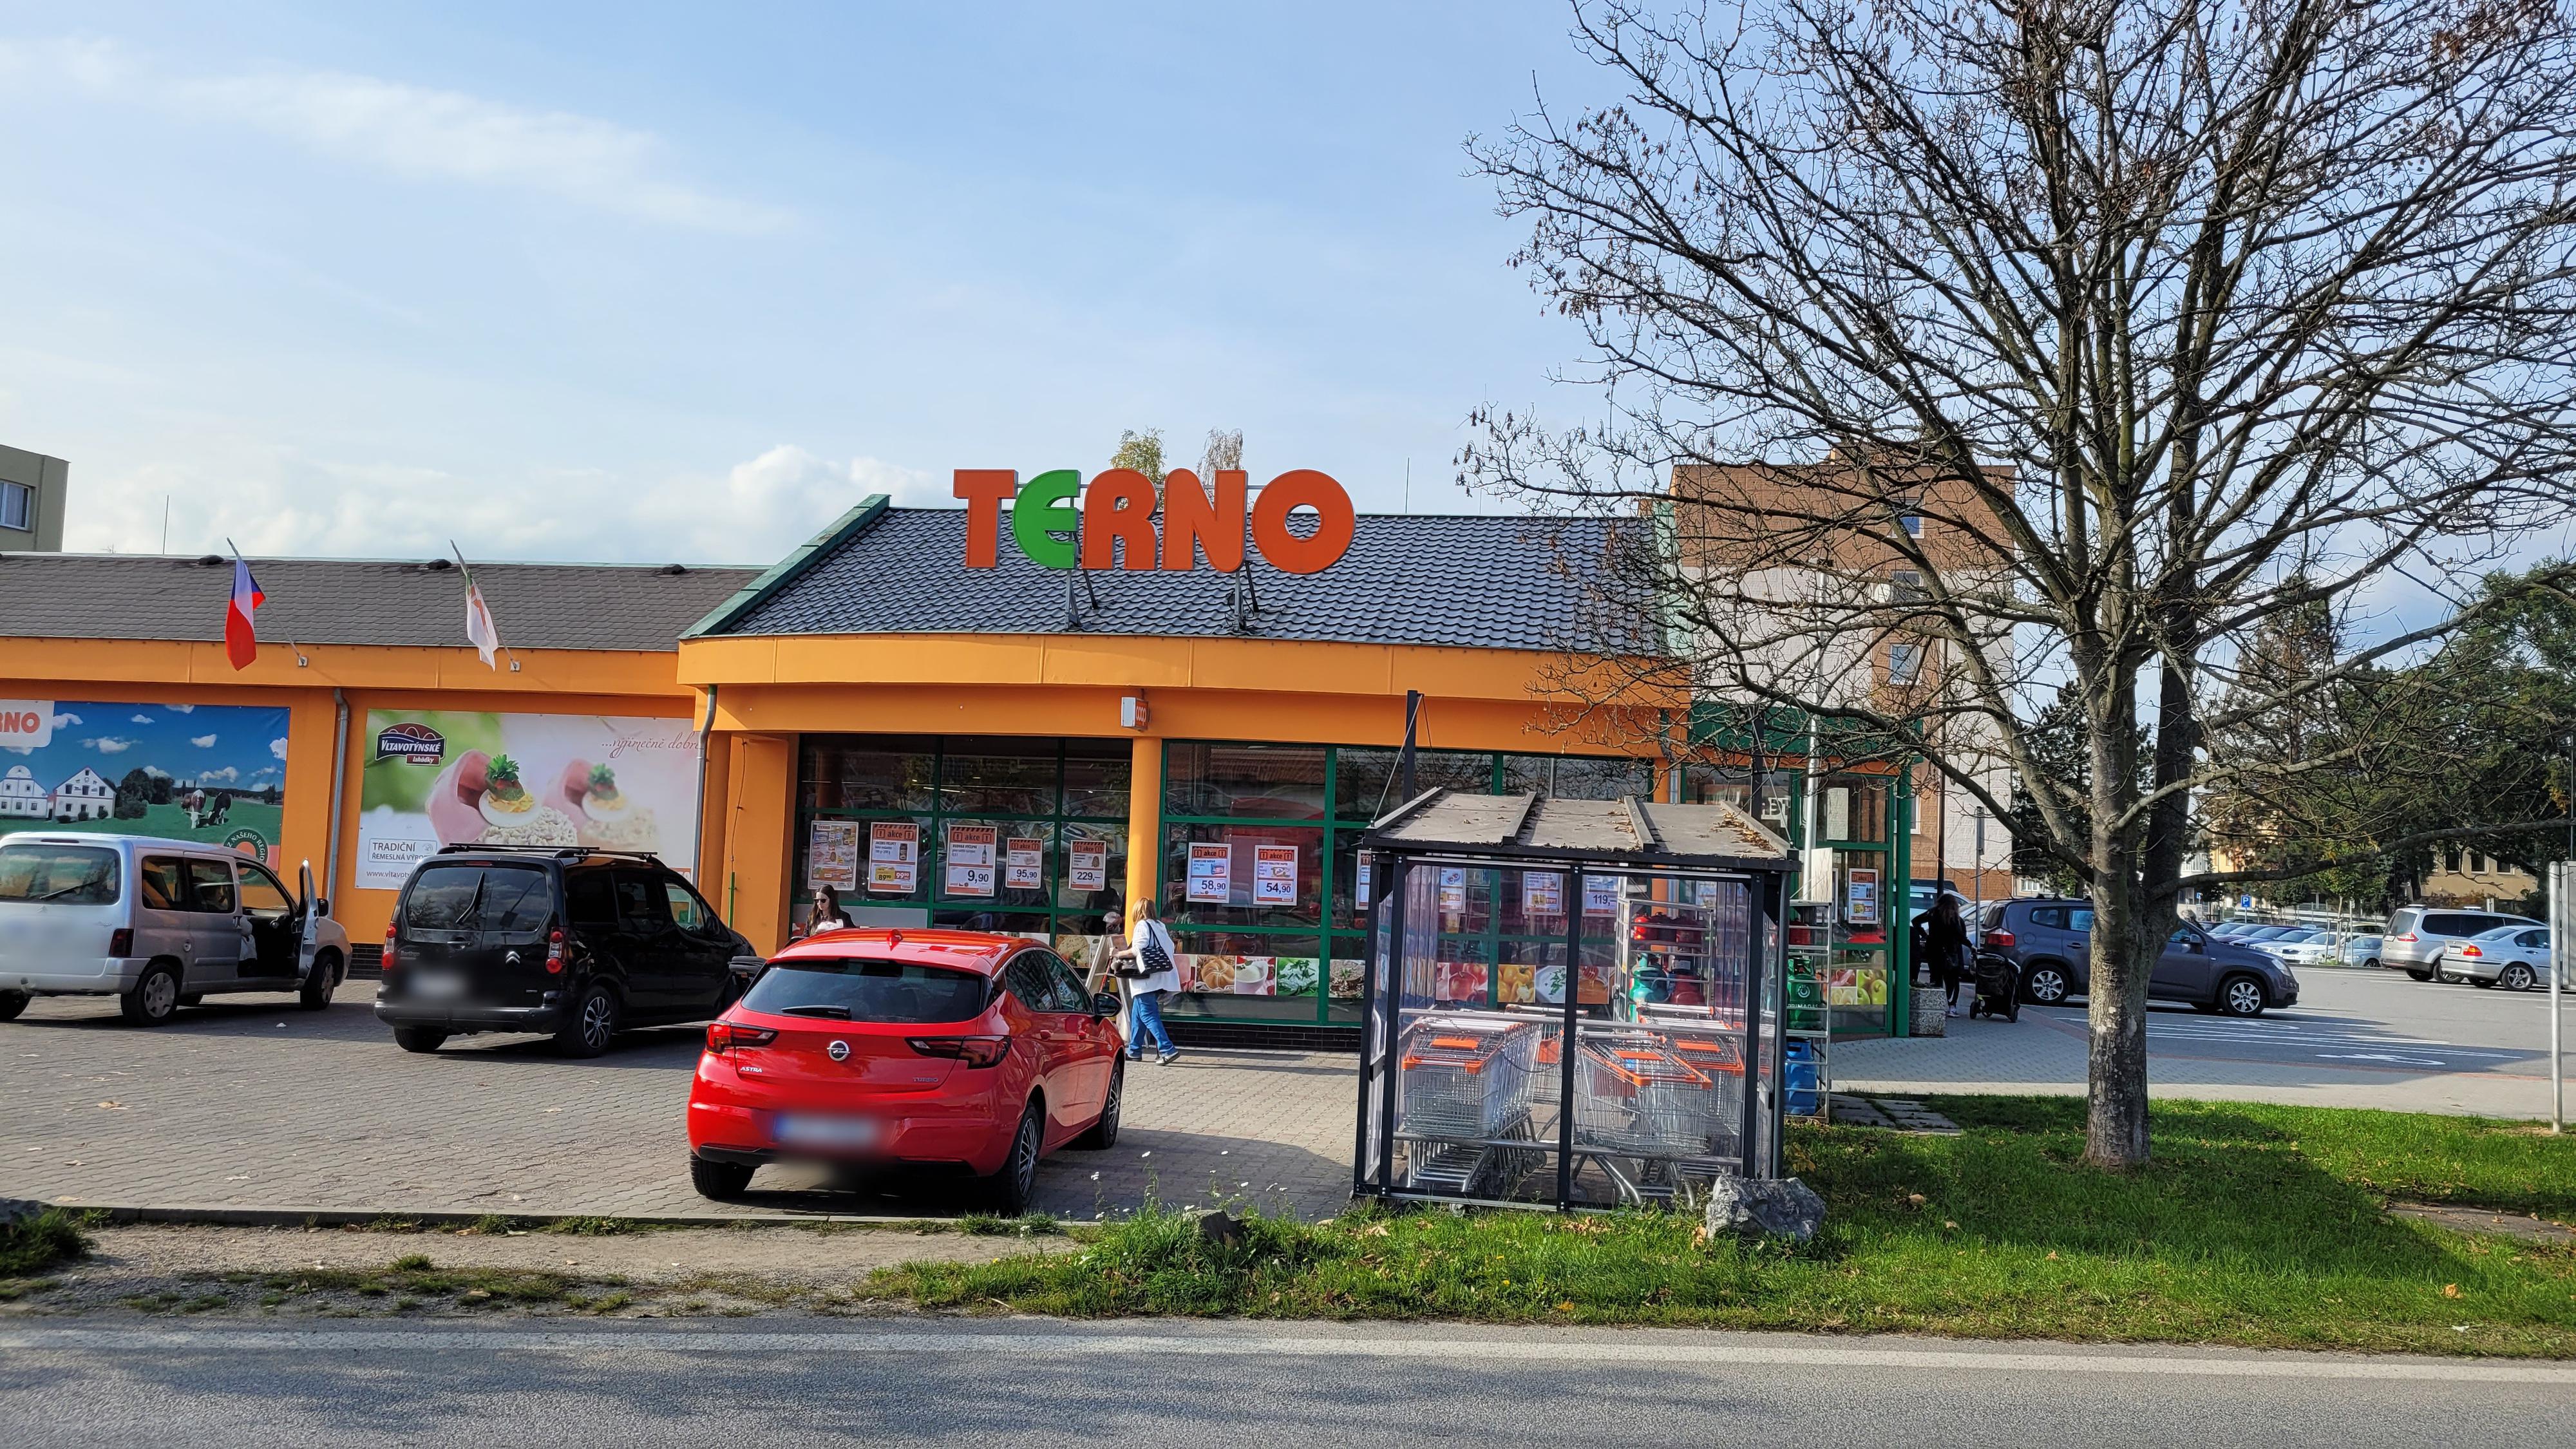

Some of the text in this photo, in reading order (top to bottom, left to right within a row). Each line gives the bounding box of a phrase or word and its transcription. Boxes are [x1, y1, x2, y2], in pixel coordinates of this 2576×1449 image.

[953, 468, 1356, 574] TERNO
[0, 712, 40, 733] NO
[373, 841, 416, 851] TRADIČNÍ
[968, 870, 989, 884] 9,90
[1017, 869, 1037, 879] 95,90
[1201, 880, 1226, 891] 58,90
[1266, 882, 1291, 894] 54,90
